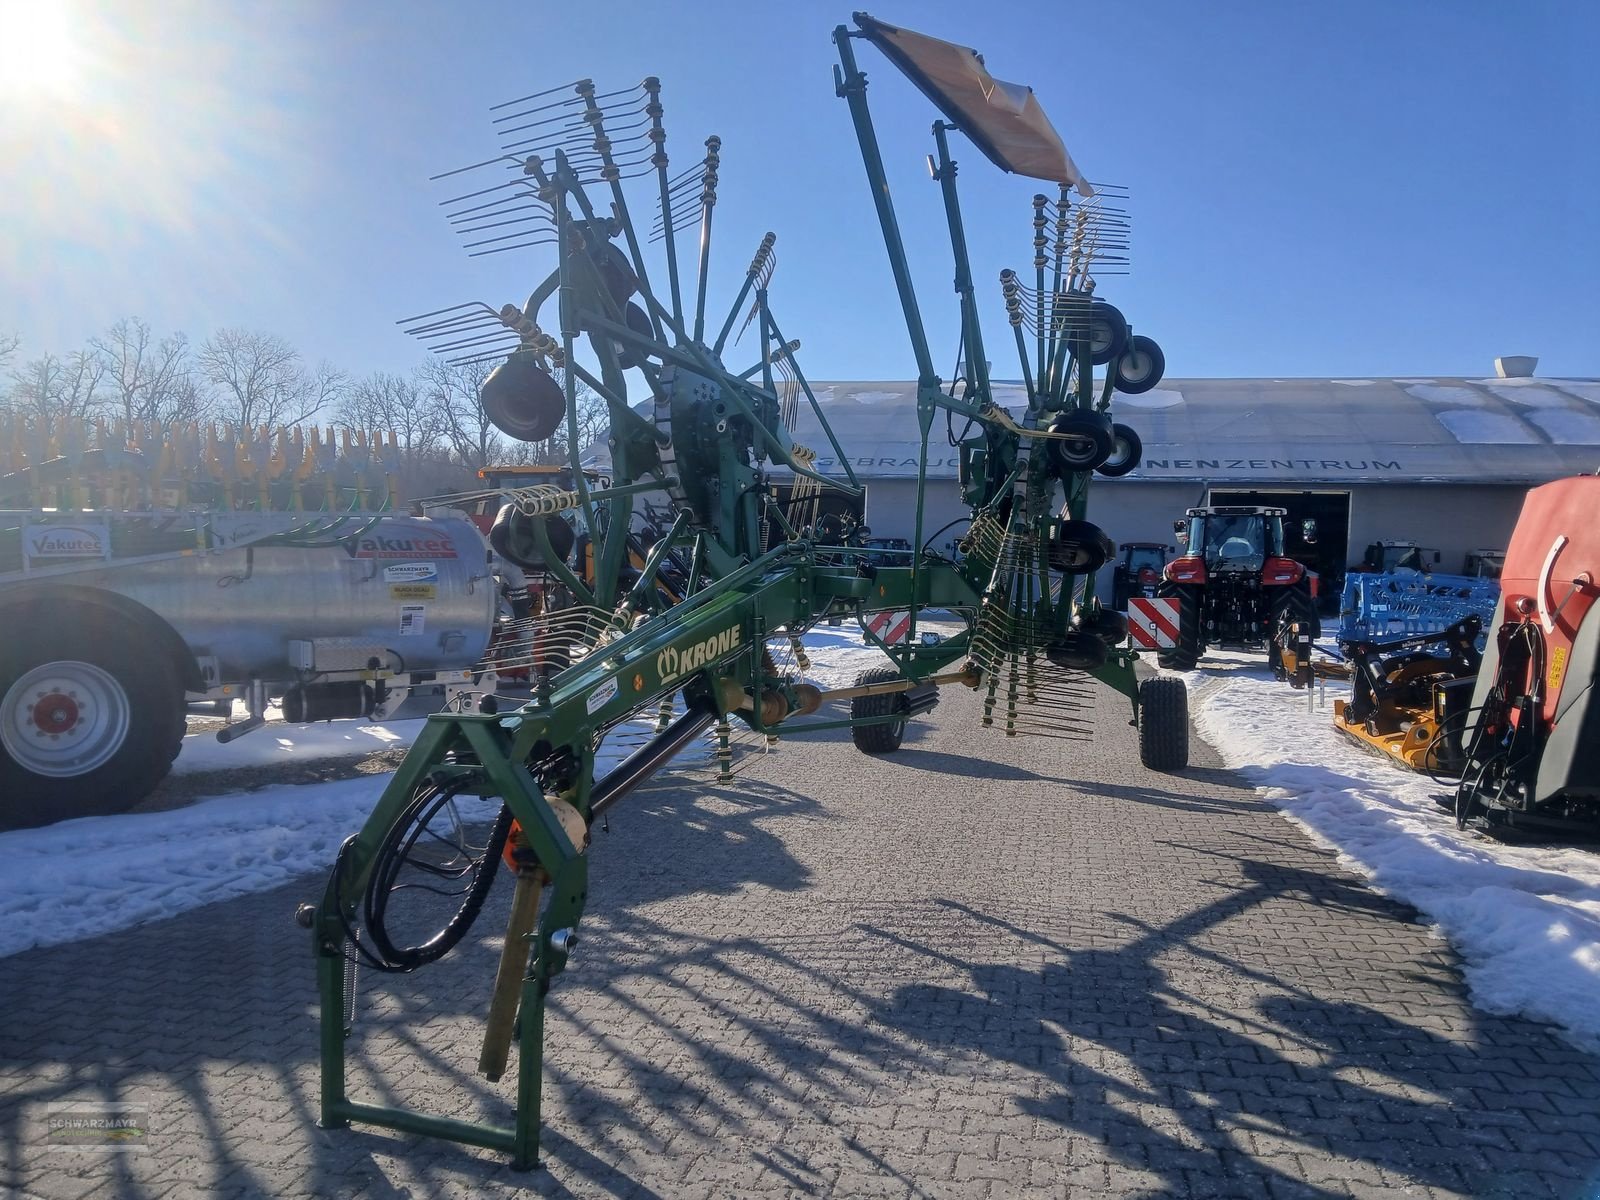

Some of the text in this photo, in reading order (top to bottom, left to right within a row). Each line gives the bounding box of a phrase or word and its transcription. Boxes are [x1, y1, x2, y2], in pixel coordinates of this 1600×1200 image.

[32, 535, 102, 554] Vakutec
[342, 535, 456, 558] Vakutec
[680, 624, 740, 676] KRONE
